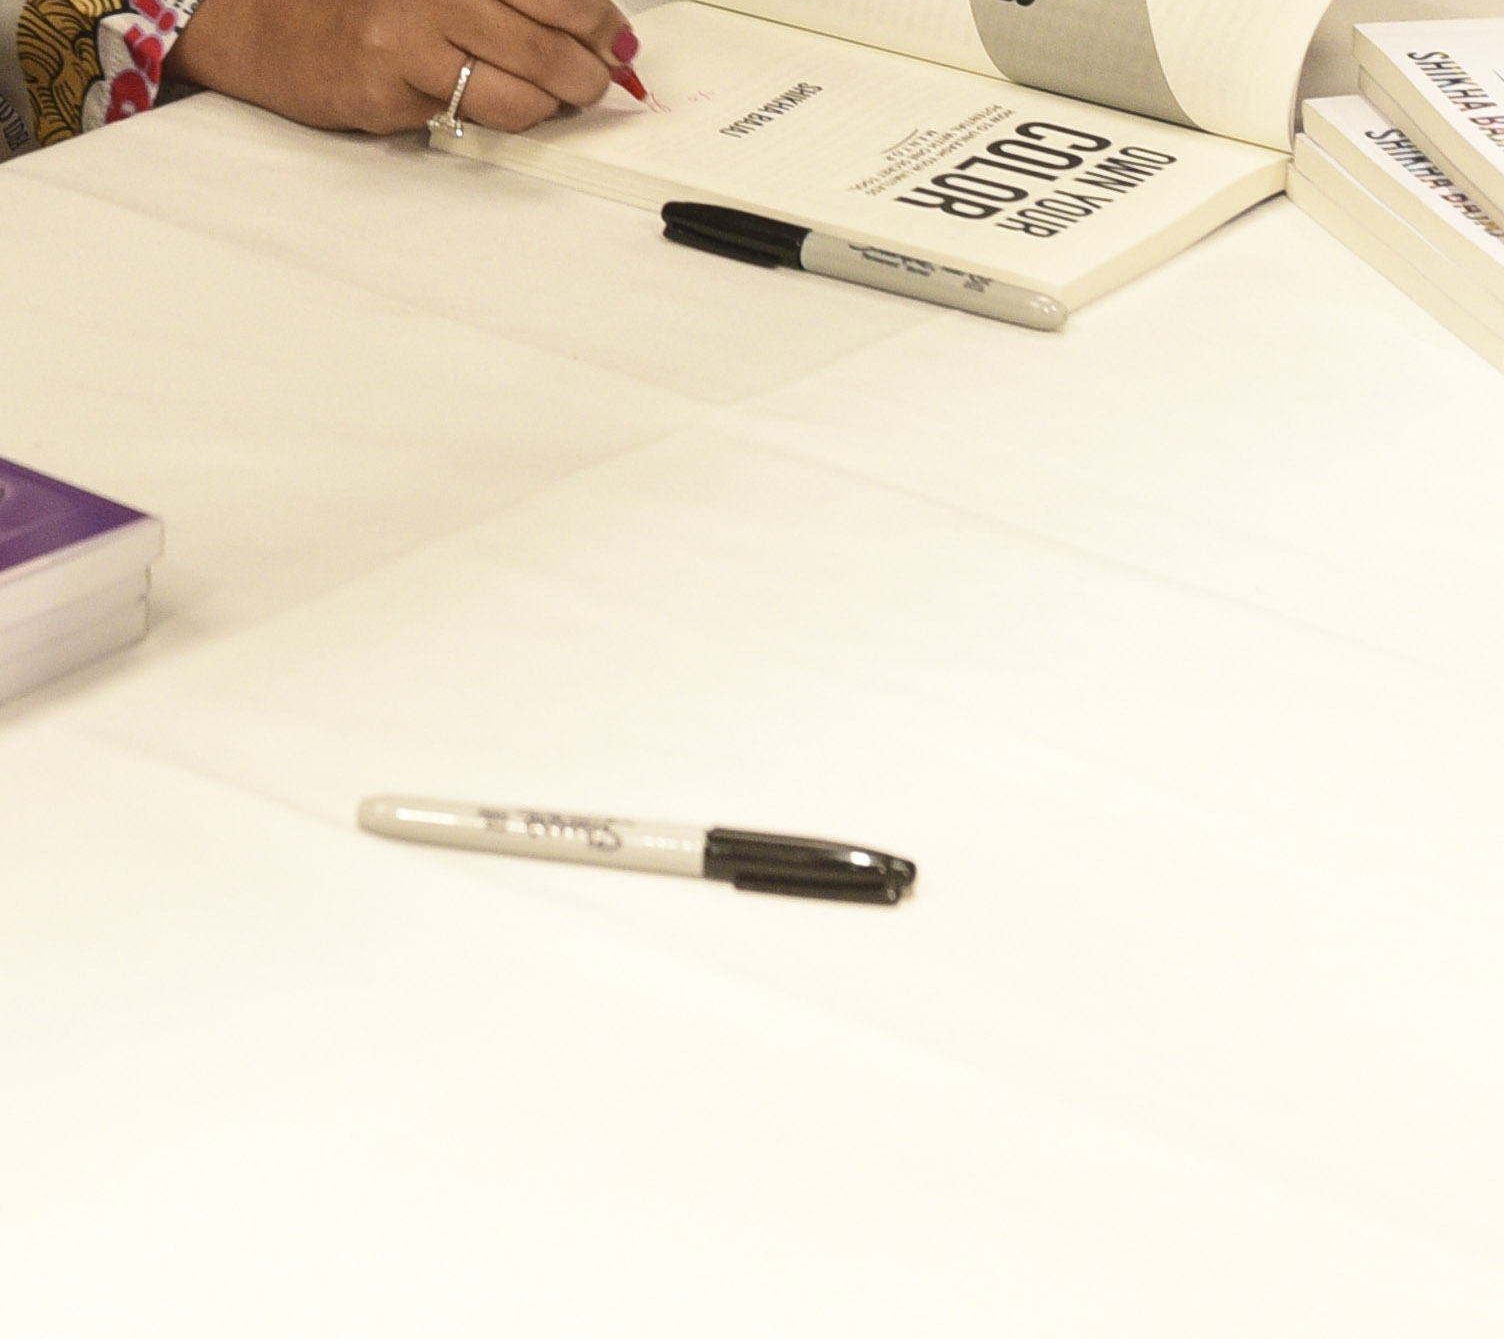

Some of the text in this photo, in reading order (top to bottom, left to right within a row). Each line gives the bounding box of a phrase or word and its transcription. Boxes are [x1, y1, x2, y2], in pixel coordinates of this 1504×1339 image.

[757, 81, 824, 115] SHIKHA
[1406, 50, 1498, 115] SHIKHA
[893, 122, 1111, 220] COLOR
[996, 145, 1178, 239] OWN YOUR
[1364, 127, 1454, 192] SHIKHA
